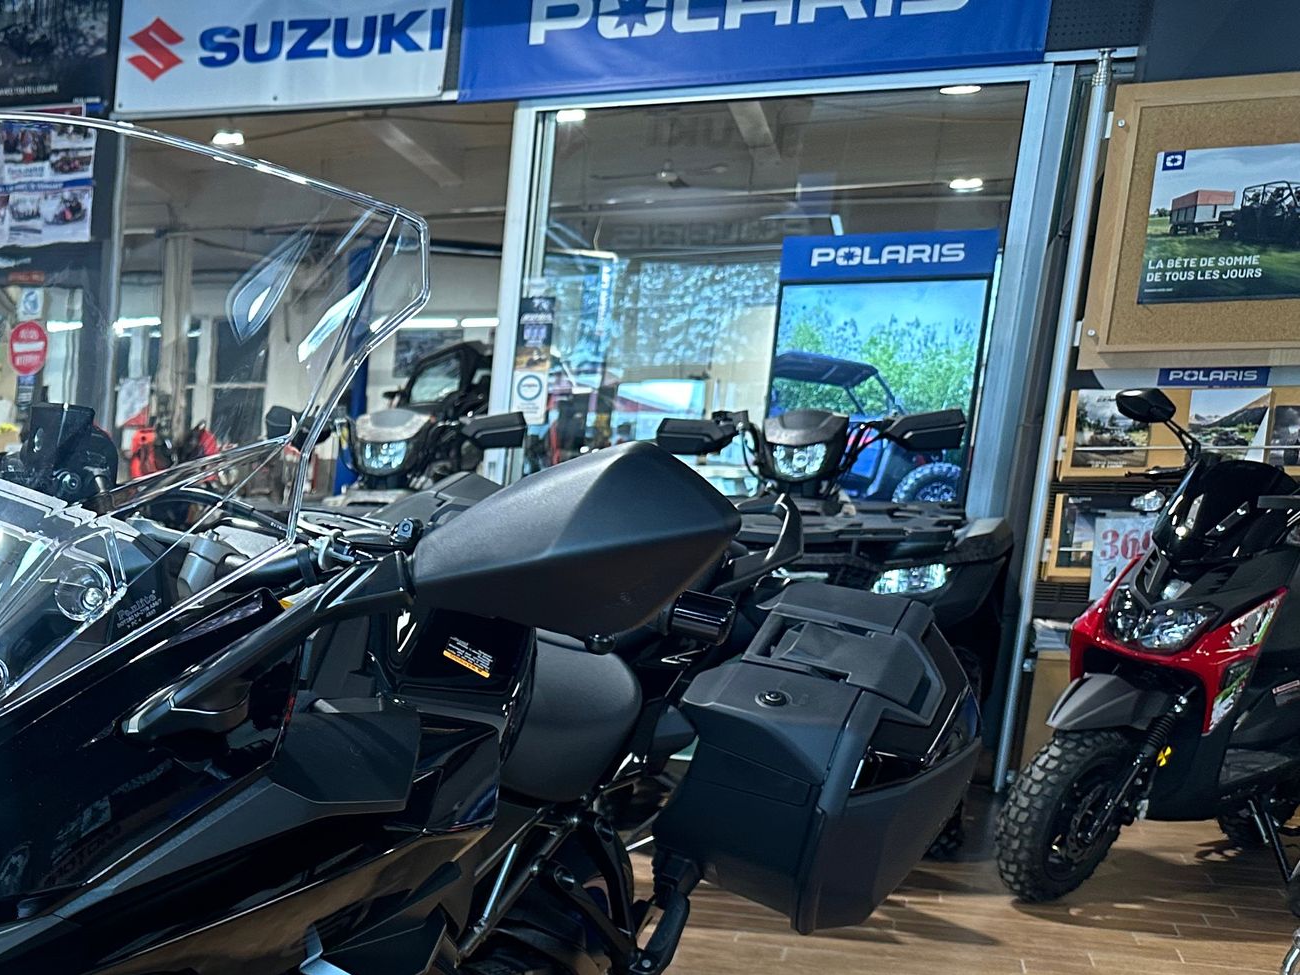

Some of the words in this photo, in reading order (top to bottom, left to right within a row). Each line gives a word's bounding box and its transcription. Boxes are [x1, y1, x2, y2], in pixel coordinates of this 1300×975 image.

[527, 0, 971, 46] POLA
[198, 8, 447, 68] SUZUKI
[809, 242, 966, 267] POLARIS
[1148, 259, 1163, 269] LA
[1167, 256, 1197, 269] BÊTE
[1200, 257, 1215, 267] DE
[1218, 255, 1260, 266] SOMME
[1146, 272, 1161, 282] DE
[1164, 270, 1195, 281] TOUS
[1197, 270, 1219, 280] LES
[1222, 268, 1262, 279] JOURS
[1168, 370, 1259, 381] POLARIS
